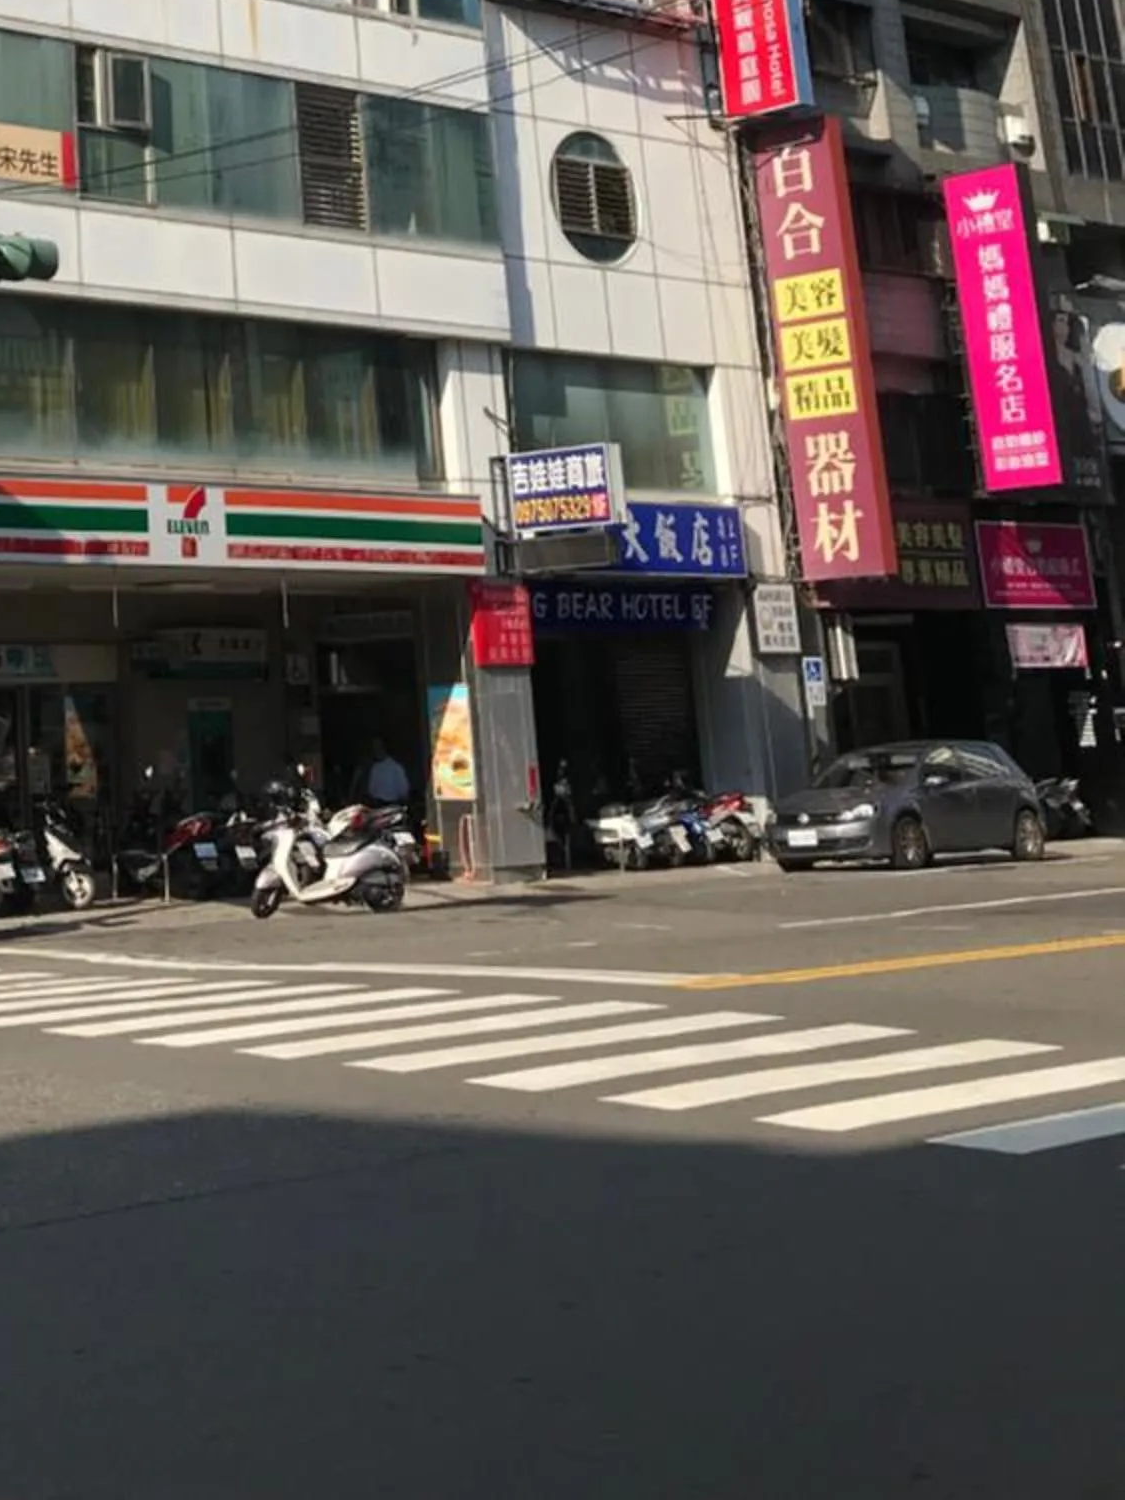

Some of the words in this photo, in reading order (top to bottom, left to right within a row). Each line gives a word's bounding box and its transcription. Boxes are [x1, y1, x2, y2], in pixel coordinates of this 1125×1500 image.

[768, 135, 826, 261] 百合
[786, 277, 836, 316] 美容
[792, 324, 844, 364] 美髮
[978, 244, 1026, 424] 媽媽禮服名店
[793, 375, 851, 413] 精品
[511, 452, 605, 496] 吉娃娃商旅
[805, 430, 864, 564] 器材
[556, 591, 613, 620] BEAR
[621, 592, 686, 620] HOTEL
